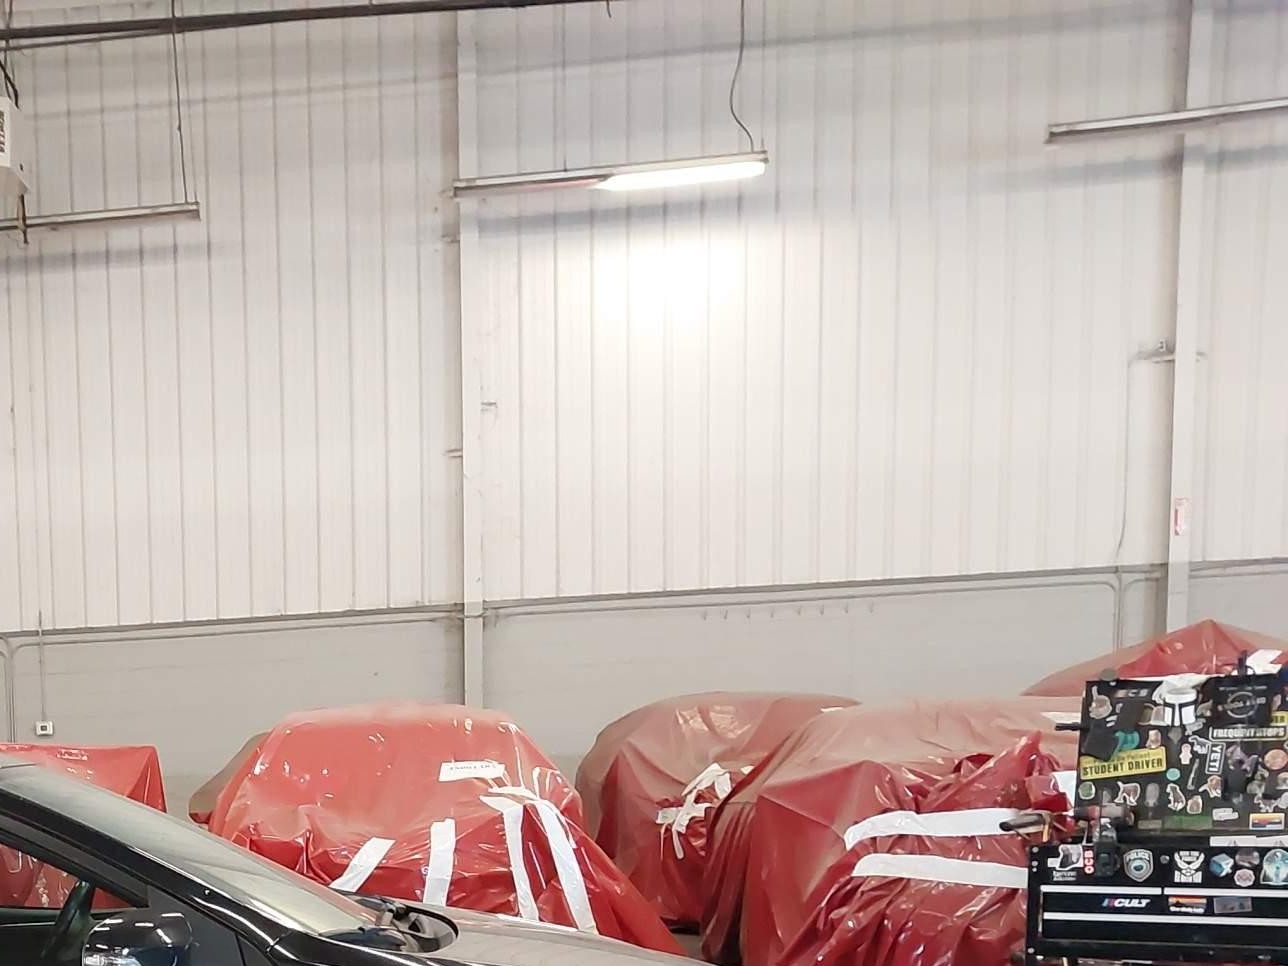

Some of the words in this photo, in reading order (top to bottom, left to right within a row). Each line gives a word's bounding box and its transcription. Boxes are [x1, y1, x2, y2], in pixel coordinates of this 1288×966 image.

[1083, 762, 1125, 776] STUDENT
[1128, 758, 1163, 771] DRIVER
[1209, 745, 1222, 772] YETI
[1084, 850, 1094, 874] OCB
